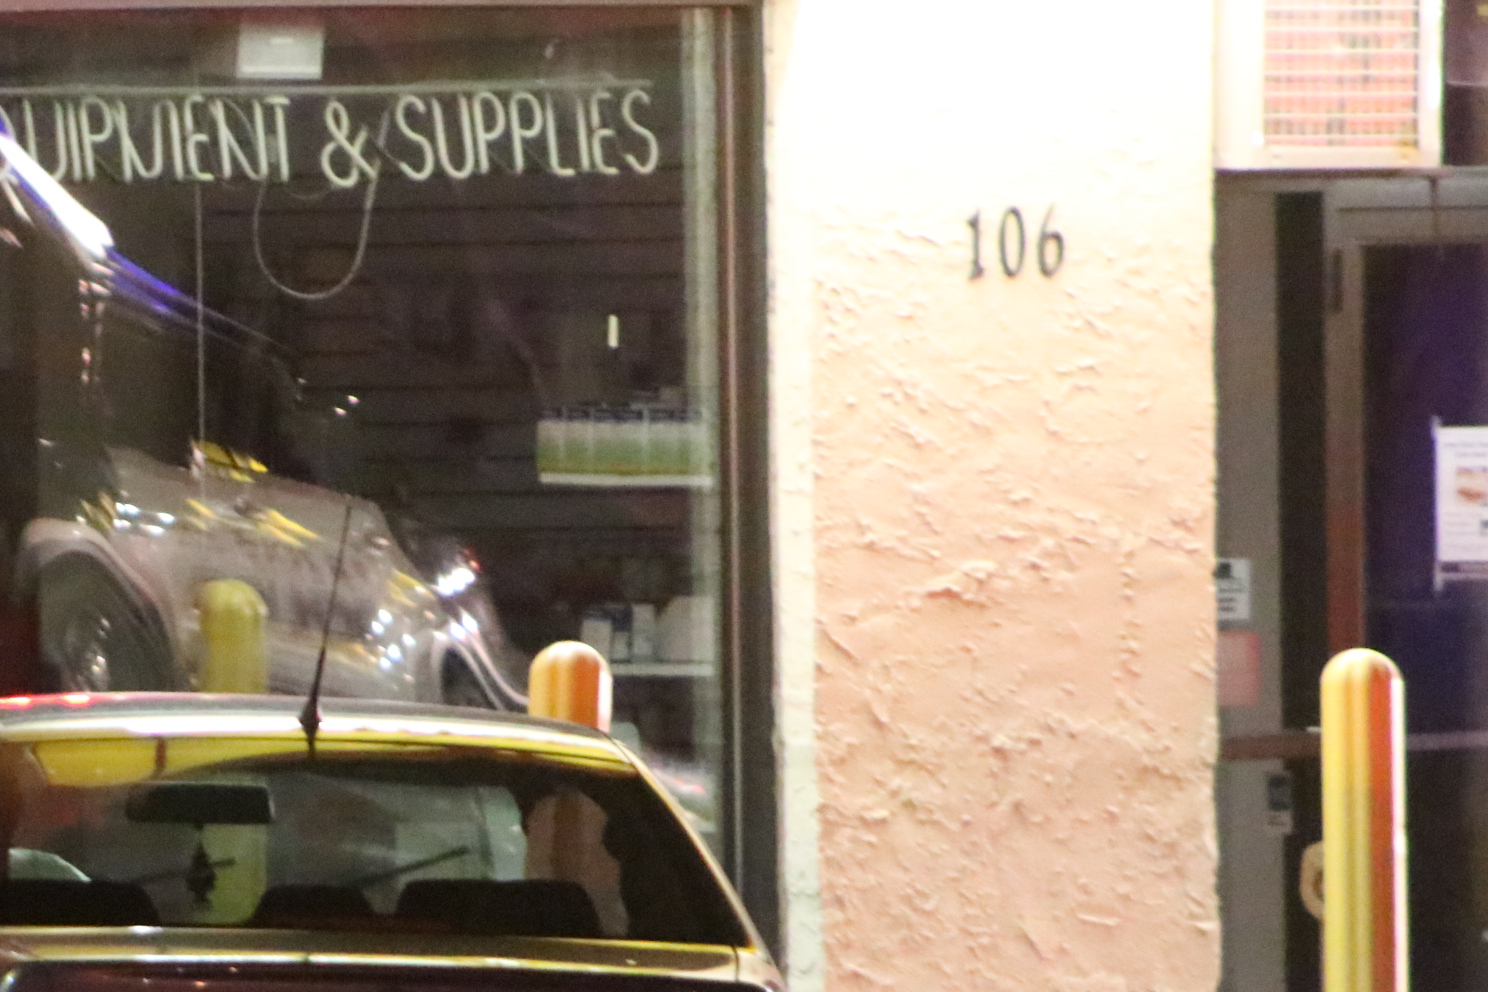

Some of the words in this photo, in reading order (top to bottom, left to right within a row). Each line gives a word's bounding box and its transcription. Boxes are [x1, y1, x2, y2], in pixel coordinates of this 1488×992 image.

[320, 100, 380, 188] &
[396, 90, 659, 178] SUPPLIES
[964, 205, 1068, 284] 106
